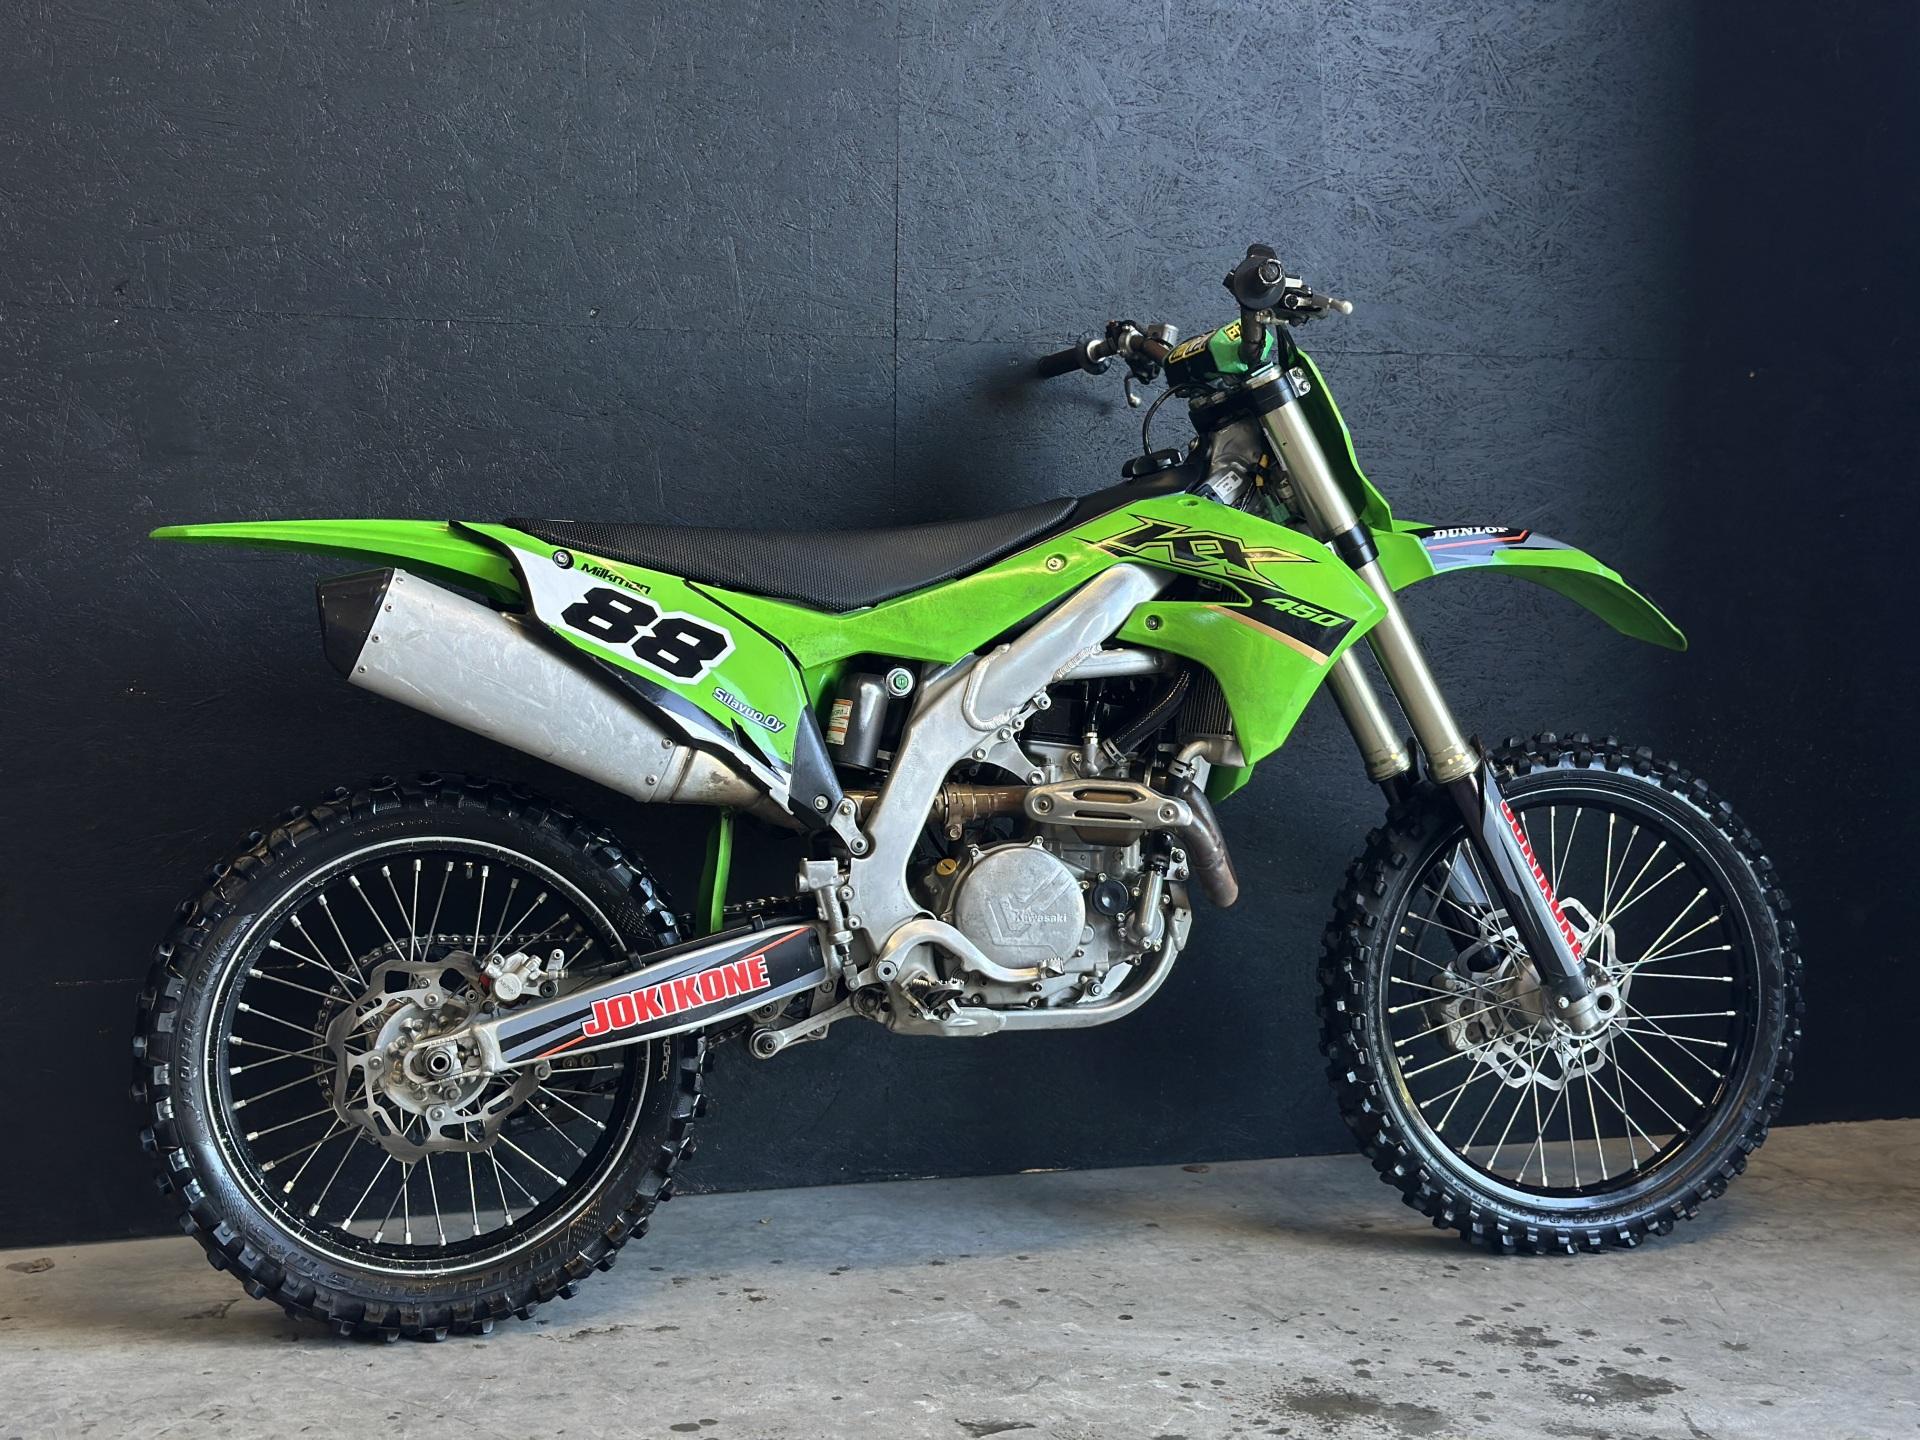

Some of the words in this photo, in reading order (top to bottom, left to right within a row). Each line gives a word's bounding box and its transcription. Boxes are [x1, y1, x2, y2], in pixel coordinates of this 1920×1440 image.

[1433, 526, 1509, 540] DUNLOP
[580, 563, 652, 595] Milkman
[1261, 597, 1348, 627] 450
[560, 586, 729, 680] 88
[713, 687, 765, 723] Silavuo
[764, 714, 786, 732] Oy
[582, 954, 771, 1038] JOKIKONE
